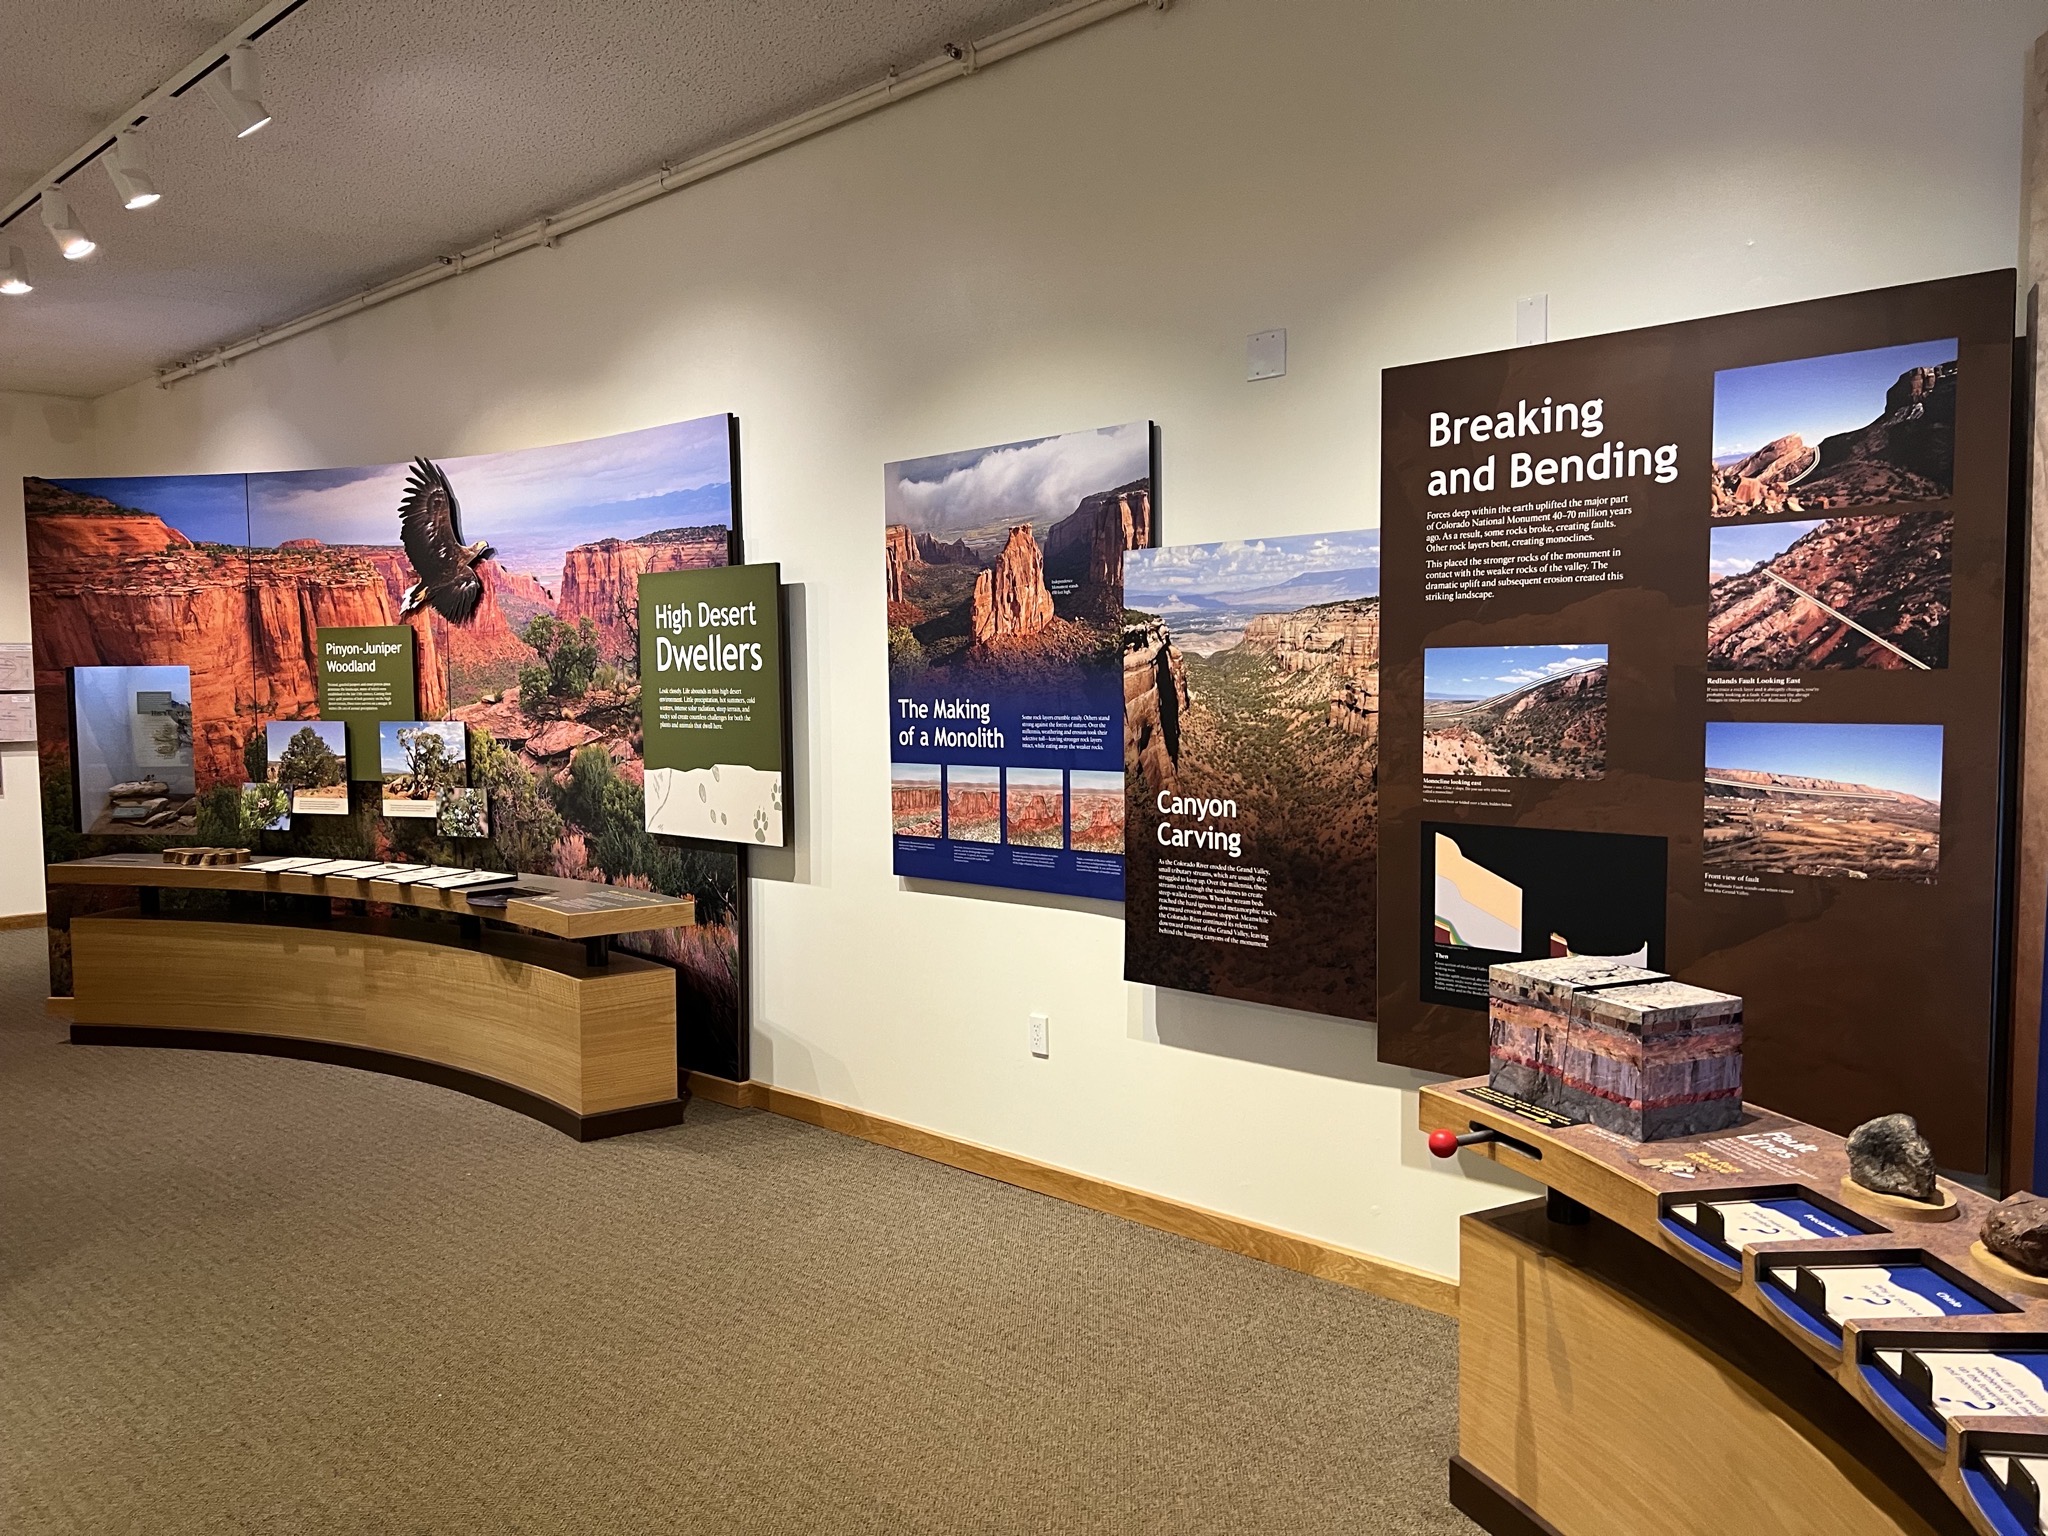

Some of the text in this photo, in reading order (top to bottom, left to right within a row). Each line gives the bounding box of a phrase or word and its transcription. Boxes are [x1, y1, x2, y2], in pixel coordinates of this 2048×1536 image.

[1430, 396, 1604, 447] Breaking
[1428, 441, 1678, 496] and Bending
[1426, 495, 1628, 520] Forces deep within the earth uplifted the major part
[1426, 522, 1434, 530] of
[1435, 520, 1470, 530] Colorado
[1471, 517, 1505, 527] National
[1506, 513, 1550, 524] Monument
[1577, 508, 1608, 518] million
[1609, 509, 1632, 519] years
[1425, 533, 1595, 552] Other rock layers bent, creating monoclines.
[1426, 535, 1441, 544] ago.
[1442, 532, 1452, 540] As
[1459, 529, 1483, 540] result,
[1505, 526, 1527, 535] rocks
[1528, 524, 1555, 535] broke,
[1555, 521, 1589, 534] creating
[1590, 519, 1617, 529] faults.
[1425, 561, 1608, 578] contact with the weaker rocks of the valley. The
[1426, 548, 1621, 570] This placed the stronger rocks of the monument in
[1425, 572, 1623, 590] dramatic uplift and subsequent erosion created this
[1425, 590, 1495, 603] striking landscape.
[656, 601, 756, 634] High Desert
[326, 642, 402, 657] Pinyon-Juniper
[657, 634, 762, 672] Dwellers
[327, 660, 375, 672] Woodland
[898, 699, 990, 723] The Making
[899, 726, 1004, 748] of a Monolith
[1158, 790, 1236, 821] Canyon
[1158, 822, 1241, 857] Carving
[1704, 872, 1721, 880] Front
[1166, 913, 1188, 921] Colorado
[1737, 1134, 1798, 1159] Lines
[1763, 1132, 1819, 1152] Fault
